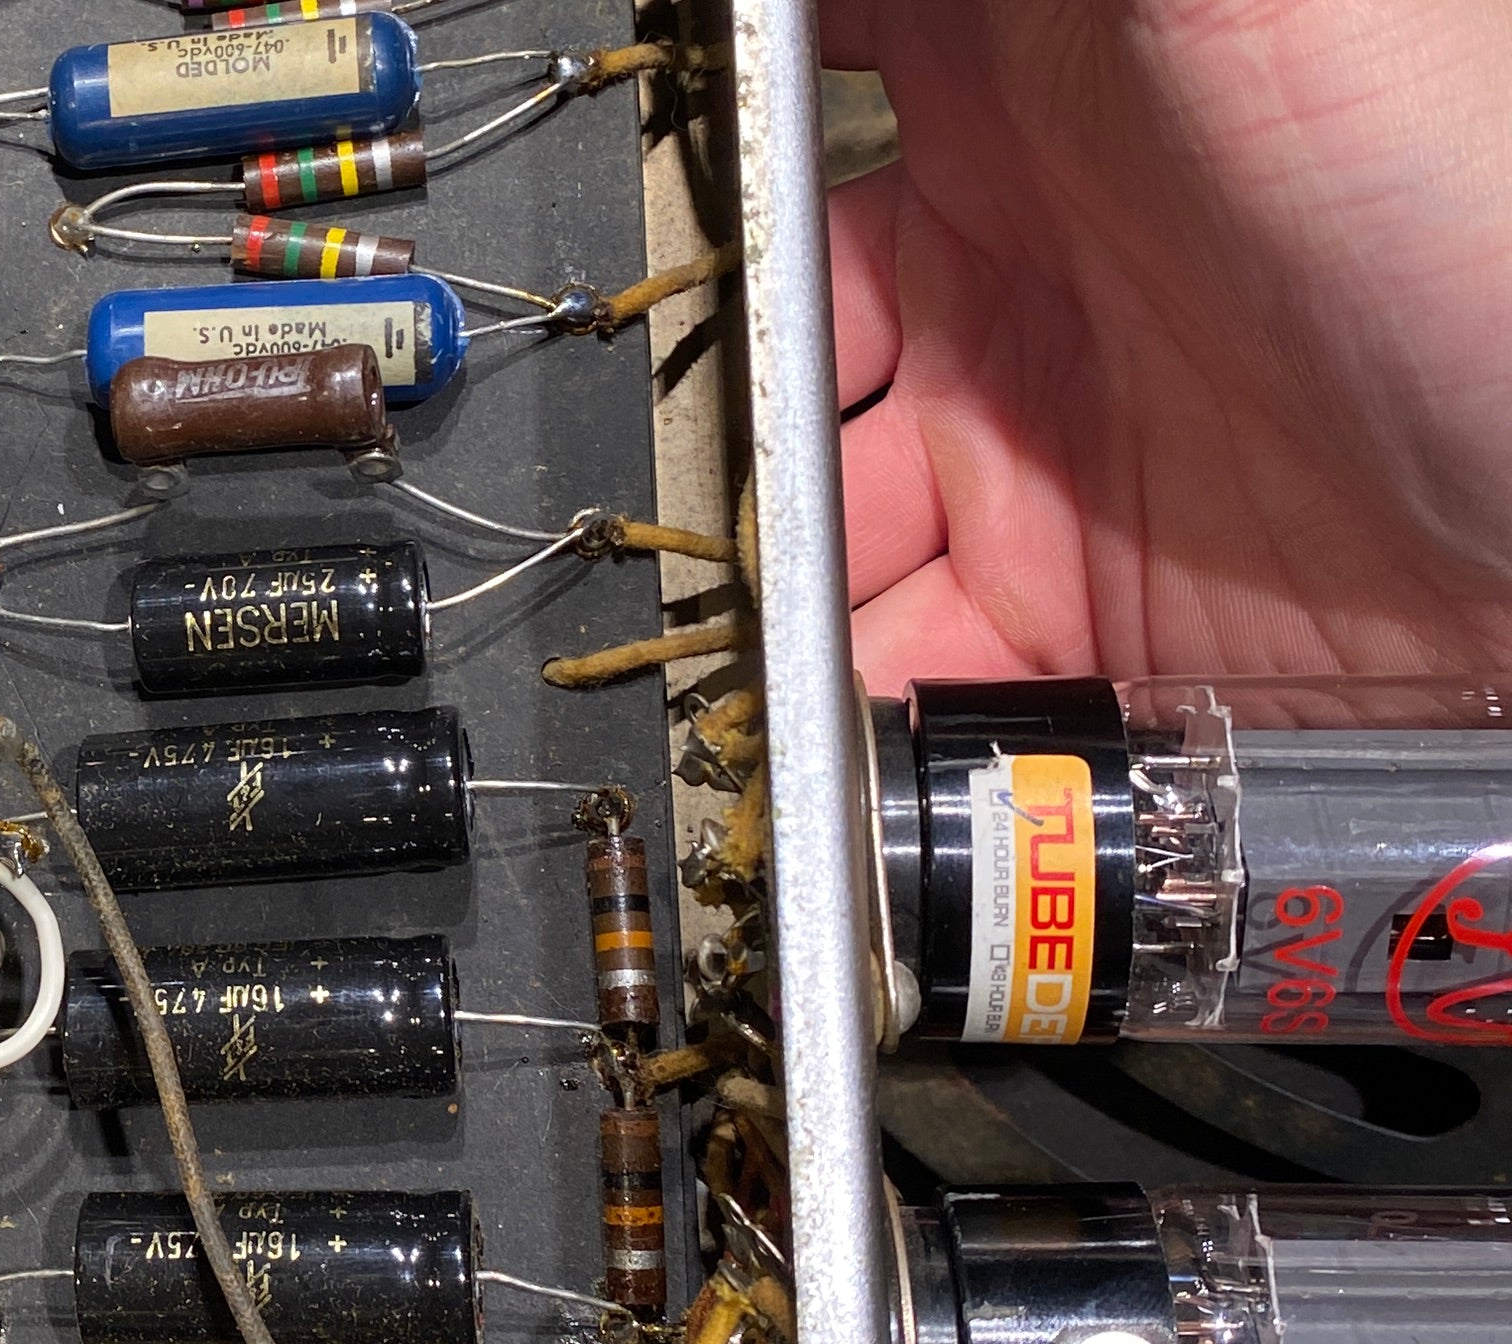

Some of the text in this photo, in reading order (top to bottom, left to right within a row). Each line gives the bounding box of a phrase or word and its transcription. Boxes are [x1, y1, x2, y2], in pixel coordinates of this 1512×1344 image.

[178, 38, 290, 60] .047-600vdc
[176, 55, 270, 79] MOLDED
[241, 324, 260, 342] in
[268, 321, 327, 340] Made
[186, 598, 341, 652] MERSEN
[992, 811, 1009, 927] 24 HOUR BURN
[155, 987, 206, 1016] 475
[988, 984, 1005, 1012] HOUR
[145, 1231, 201, 1260] 75V
